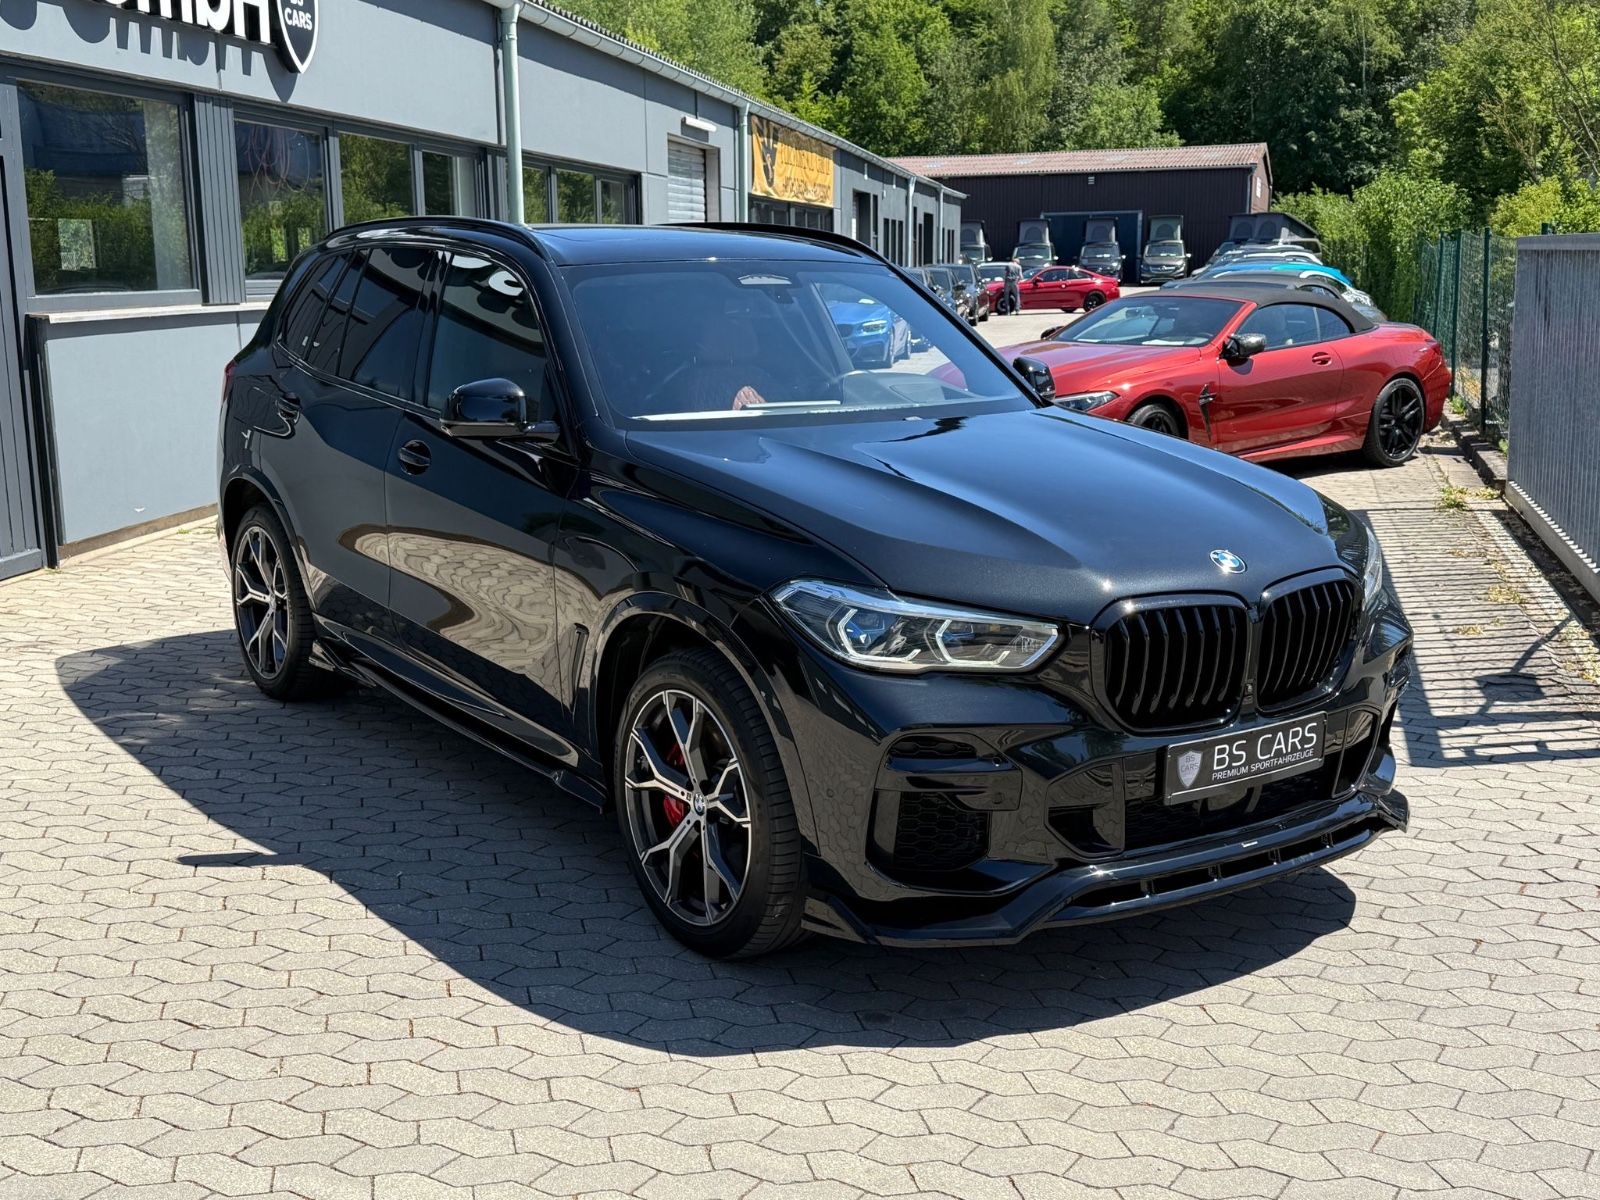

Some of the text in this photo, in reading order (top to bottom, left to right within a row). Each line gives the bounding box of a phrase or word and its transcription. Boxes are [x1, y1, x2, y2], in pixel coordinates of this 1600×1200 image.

[284, 7, 312, 30] CARS
[1213, 723, 1317, 770] BS CARS
[1211, 748, 1314, 781] PREMIUM SPORTFAHRZEUGE
